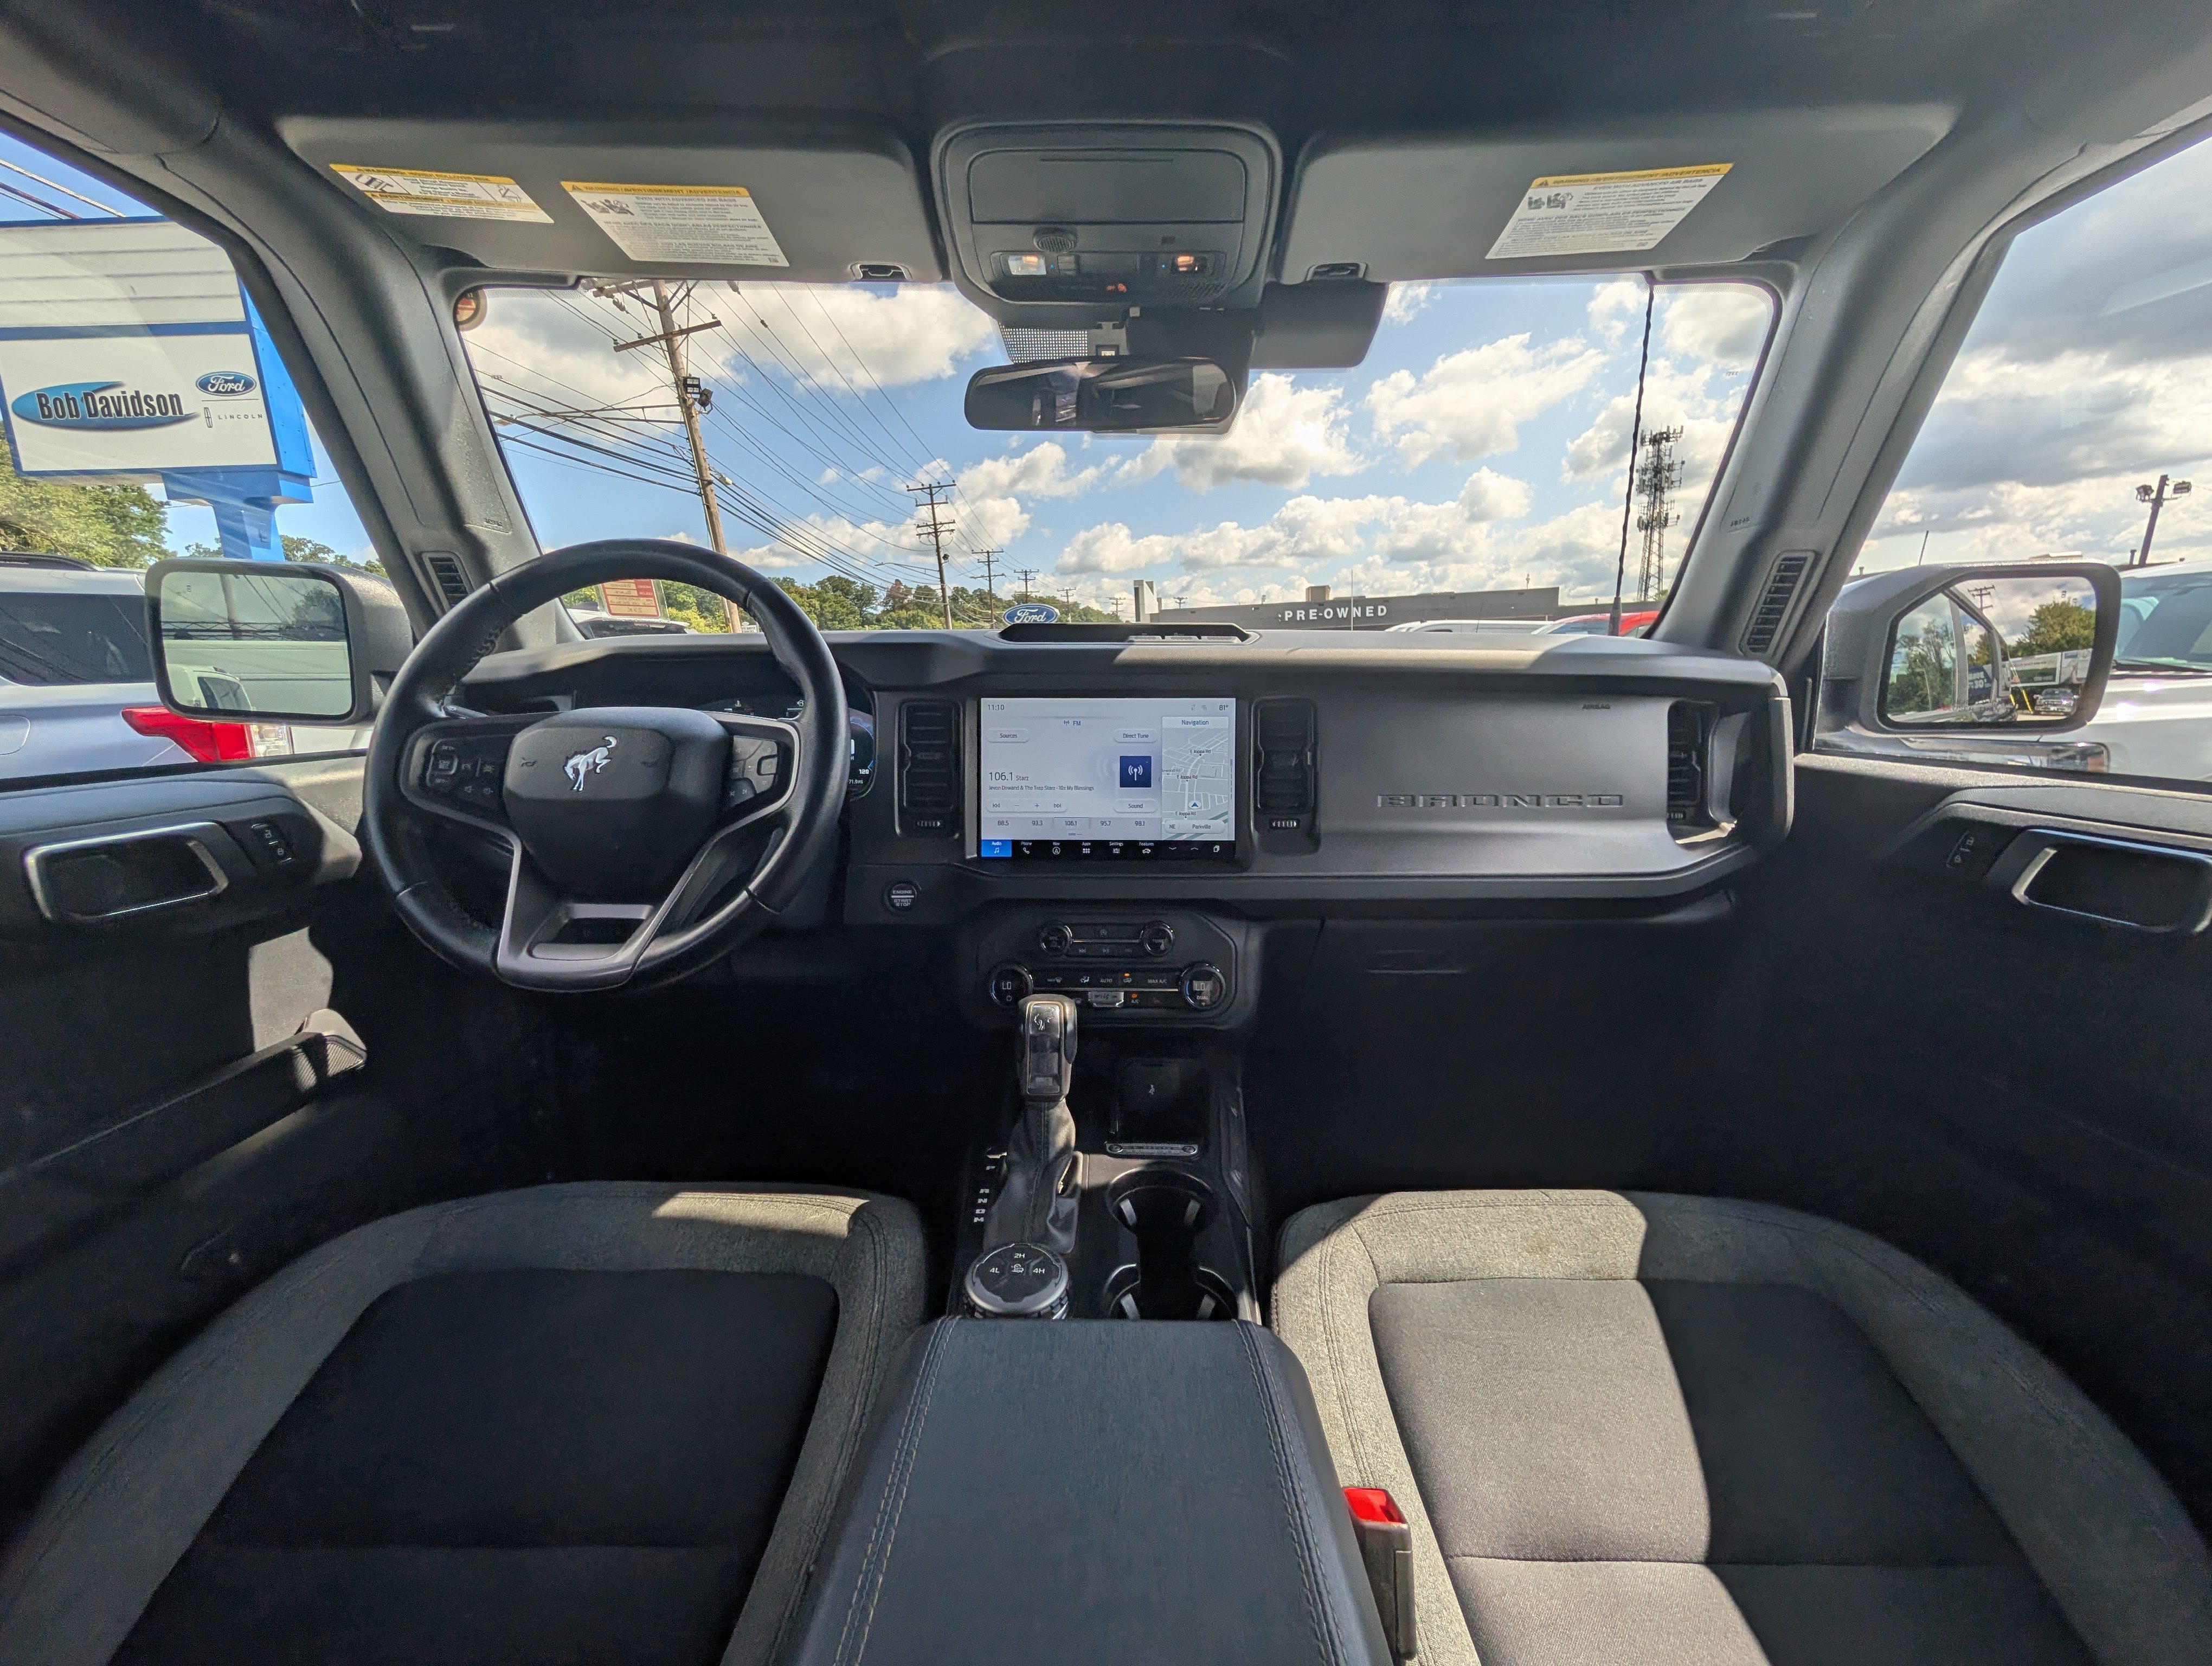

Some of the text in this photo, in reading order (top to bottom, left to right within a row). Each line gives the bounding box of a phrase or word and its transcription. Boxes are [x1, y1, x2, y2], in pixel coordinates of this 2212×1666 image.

[208, 375, 246, 392] Ford
[35, 390, 185, 420] Bob Davidson
[1014, 608, 1047, 623] Ford
[1284, 605, 1387, 621] PRE-OWNED
[988, 772, 1013, 781] 106.1
[1377, 794, 1623, 807] BRONCO
[1002, 982, 1012, 990] LO
